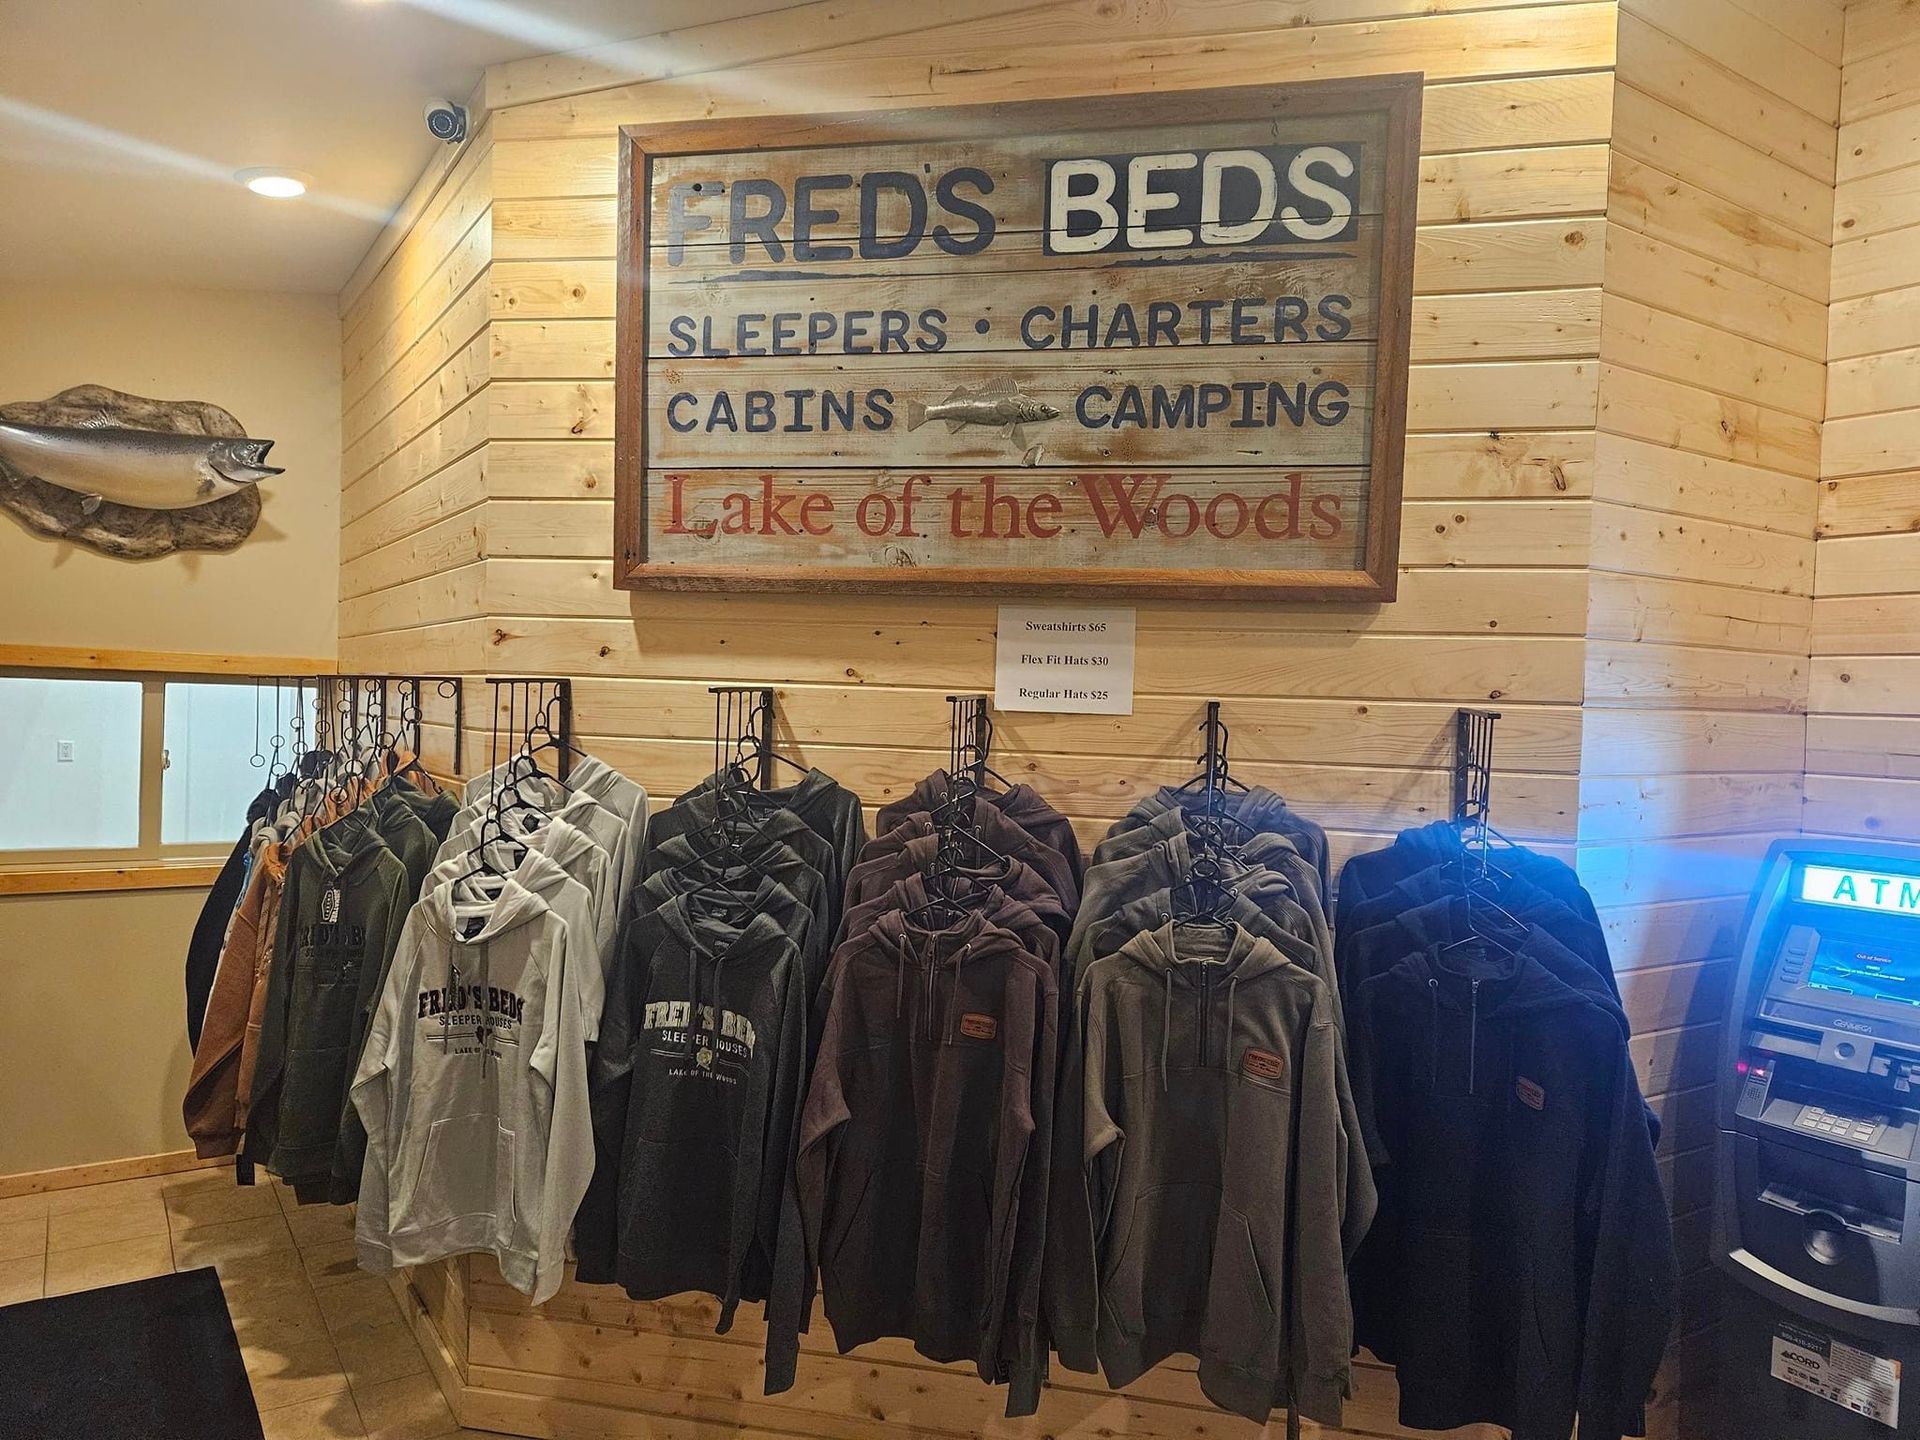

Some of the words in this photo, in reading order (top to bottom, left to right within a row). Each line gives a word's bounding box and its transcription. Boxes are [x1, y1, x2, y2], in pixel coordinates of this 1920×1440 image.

[1050, 146, 1354, 253] BEDS
[667, 308, 948, 356] SLEEPERS
[1020, 294, 1352, 349] CHARTERS
[667, 388, 895, 433] CABINS
[1075, 381, 1350, 429] CAMPING
[663, 474, 835, 536] Lake
[855, 474, 933, 538] of
[946, 475, 1064, 539] the
[1077, 473, 1343, 539] Woods
[1025, 621, 1087, 632] Sweatshirts
[1088, 622, 1106, 632] $65
[1021, 654, 1043, 665] Flex
[1046, 655, 1061, 665] Fit
[1064, 655, 1089, 666] Hats
[1091, 656, 1109, 666] $30
[1019, 687, 1061, 699] Regular
[1063, 689, 1088, 700] Hats
[1091, 691, 1108, 700] $25
[1833, 875, 1920, 909] ATM
[662, 1029, 709, 1046] SLEEER
